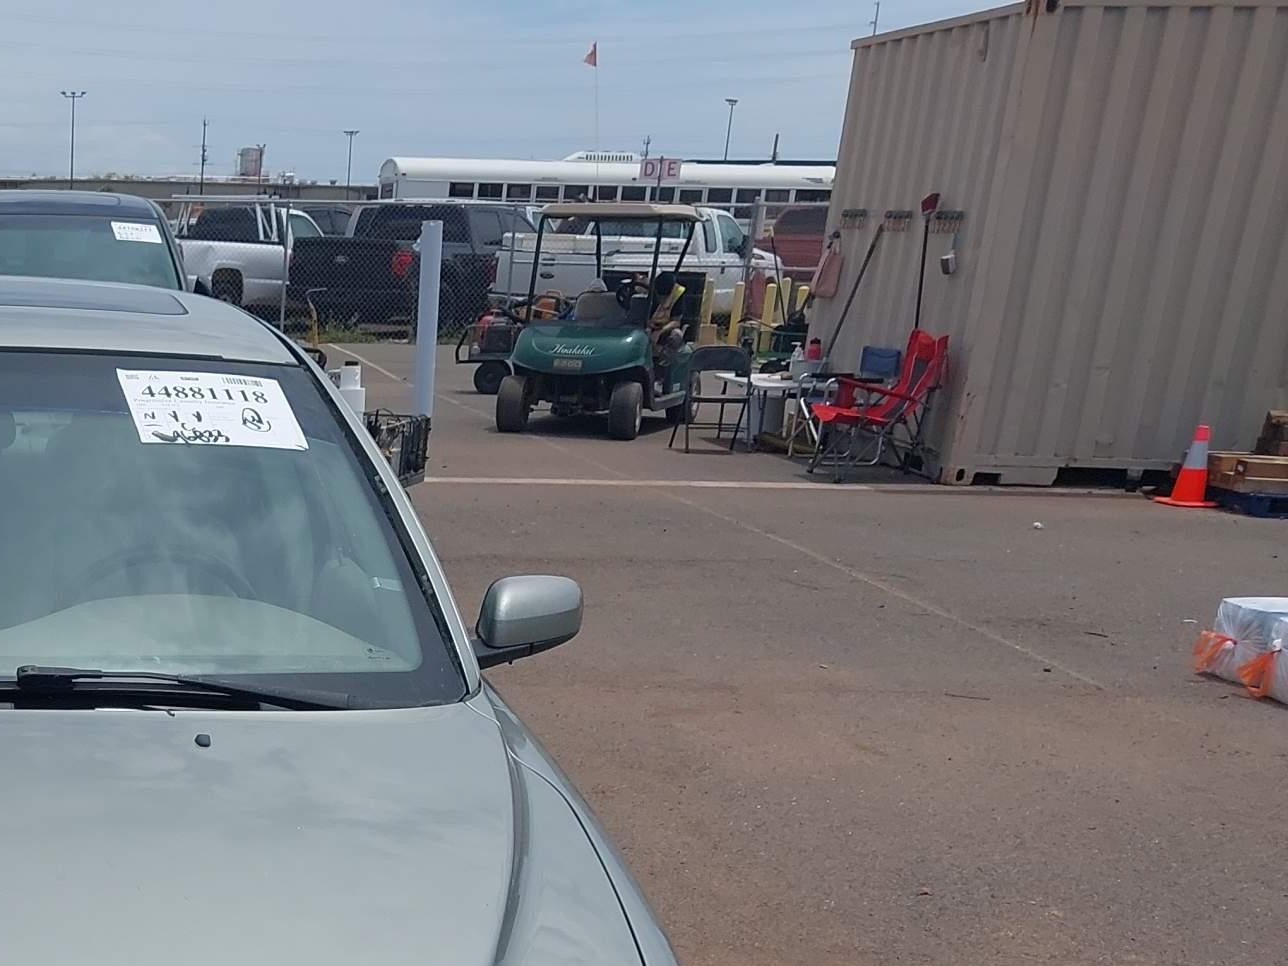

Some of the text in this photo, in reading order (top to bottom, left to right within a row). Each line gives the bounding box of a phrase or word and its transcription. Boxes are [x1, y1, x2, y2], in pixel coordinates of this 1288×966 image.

[644, 161, 677, 176] D E
[141, 385, 269, 404] 44881118
